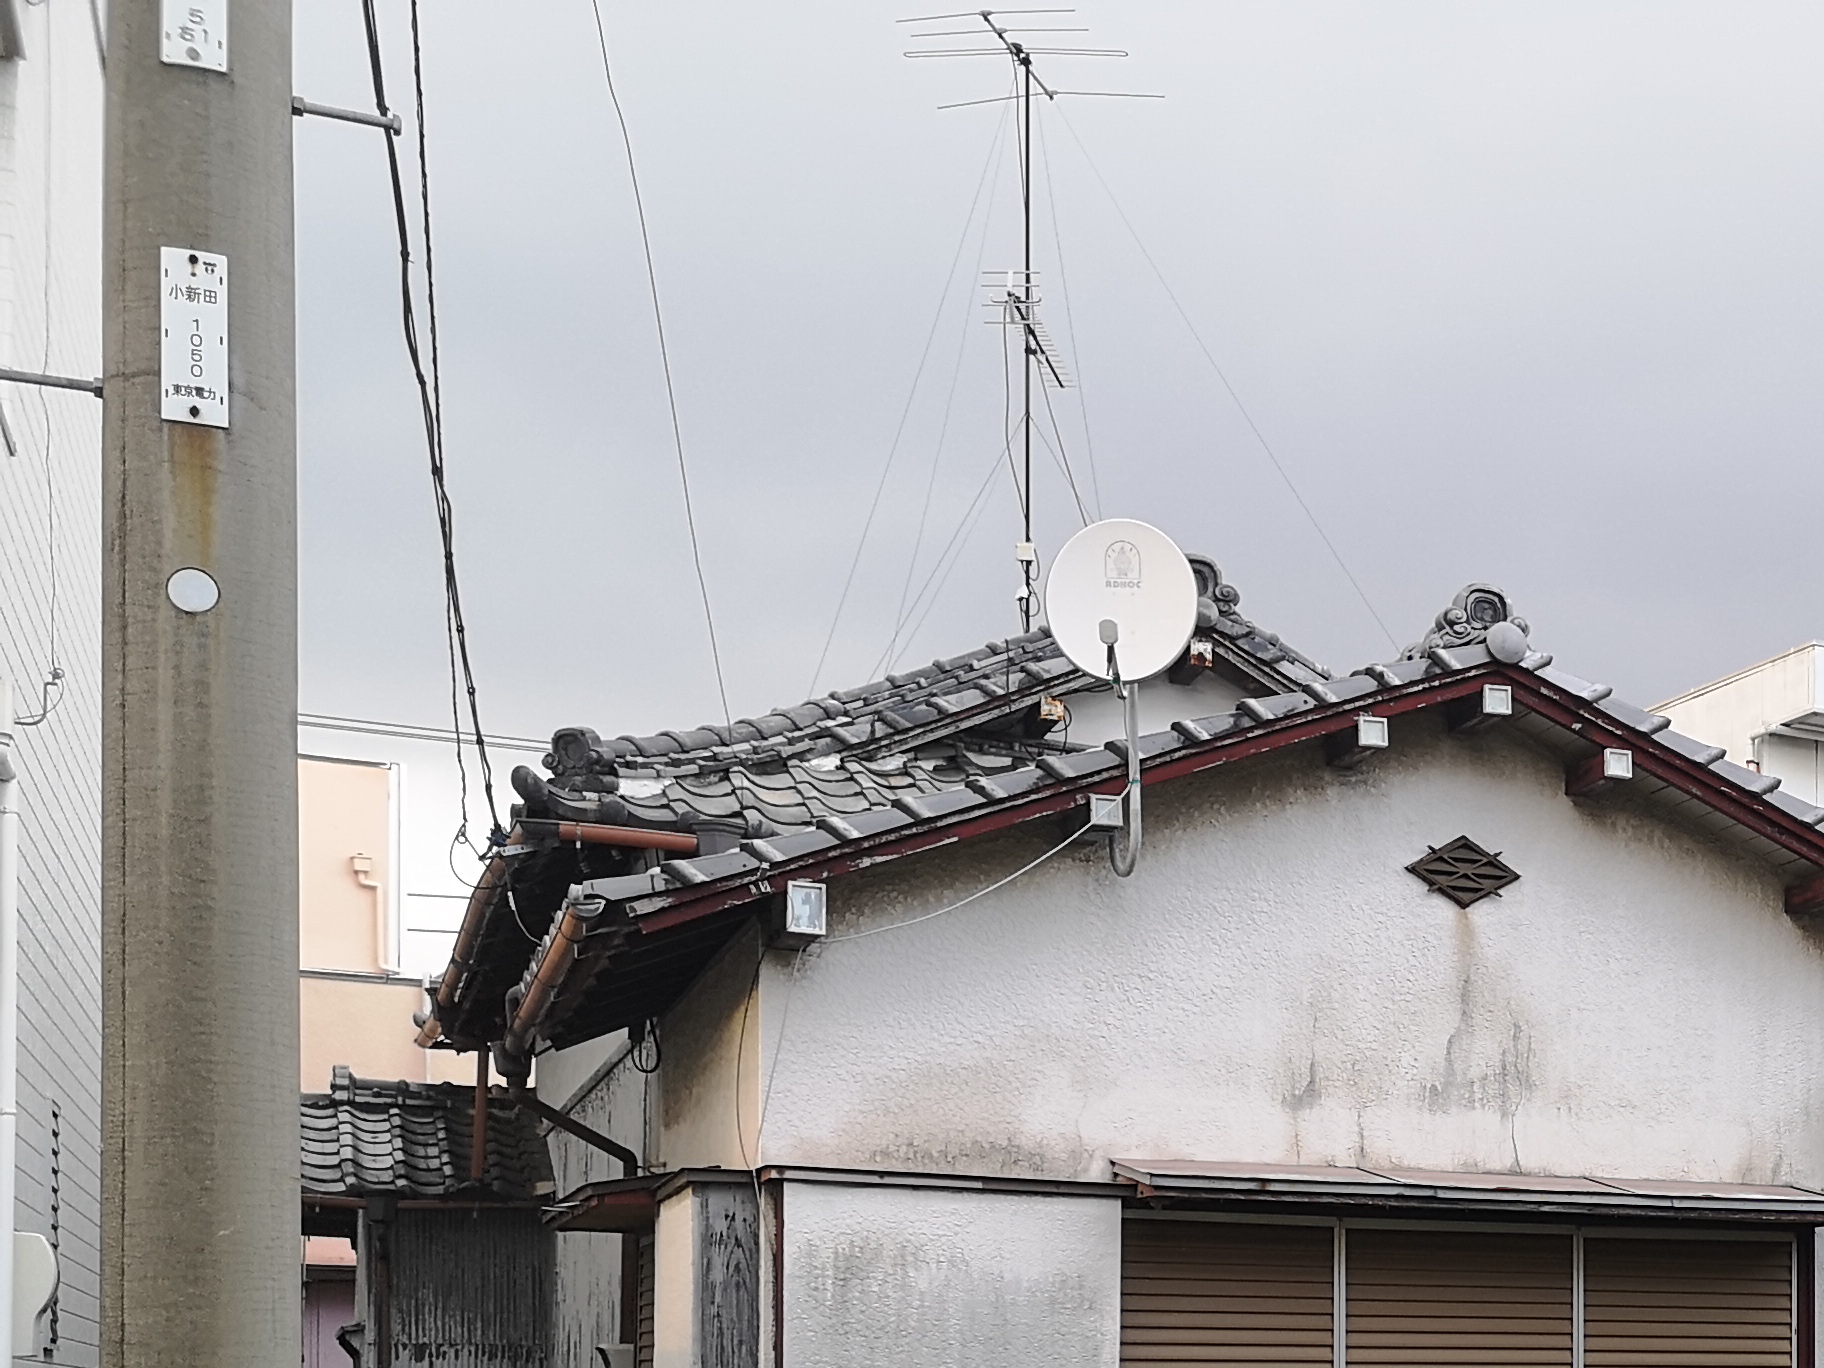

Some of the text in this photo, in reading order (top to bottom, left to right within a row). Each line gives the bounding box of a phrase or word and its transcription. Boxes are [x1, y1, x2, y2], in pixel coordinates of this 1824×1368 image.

[188, 7, 204, 25] 5
[169, 284, 217, 304] 小新田
[190, 318, 203, 378] 1050
[171, 383, 217, 401] 東京電力
